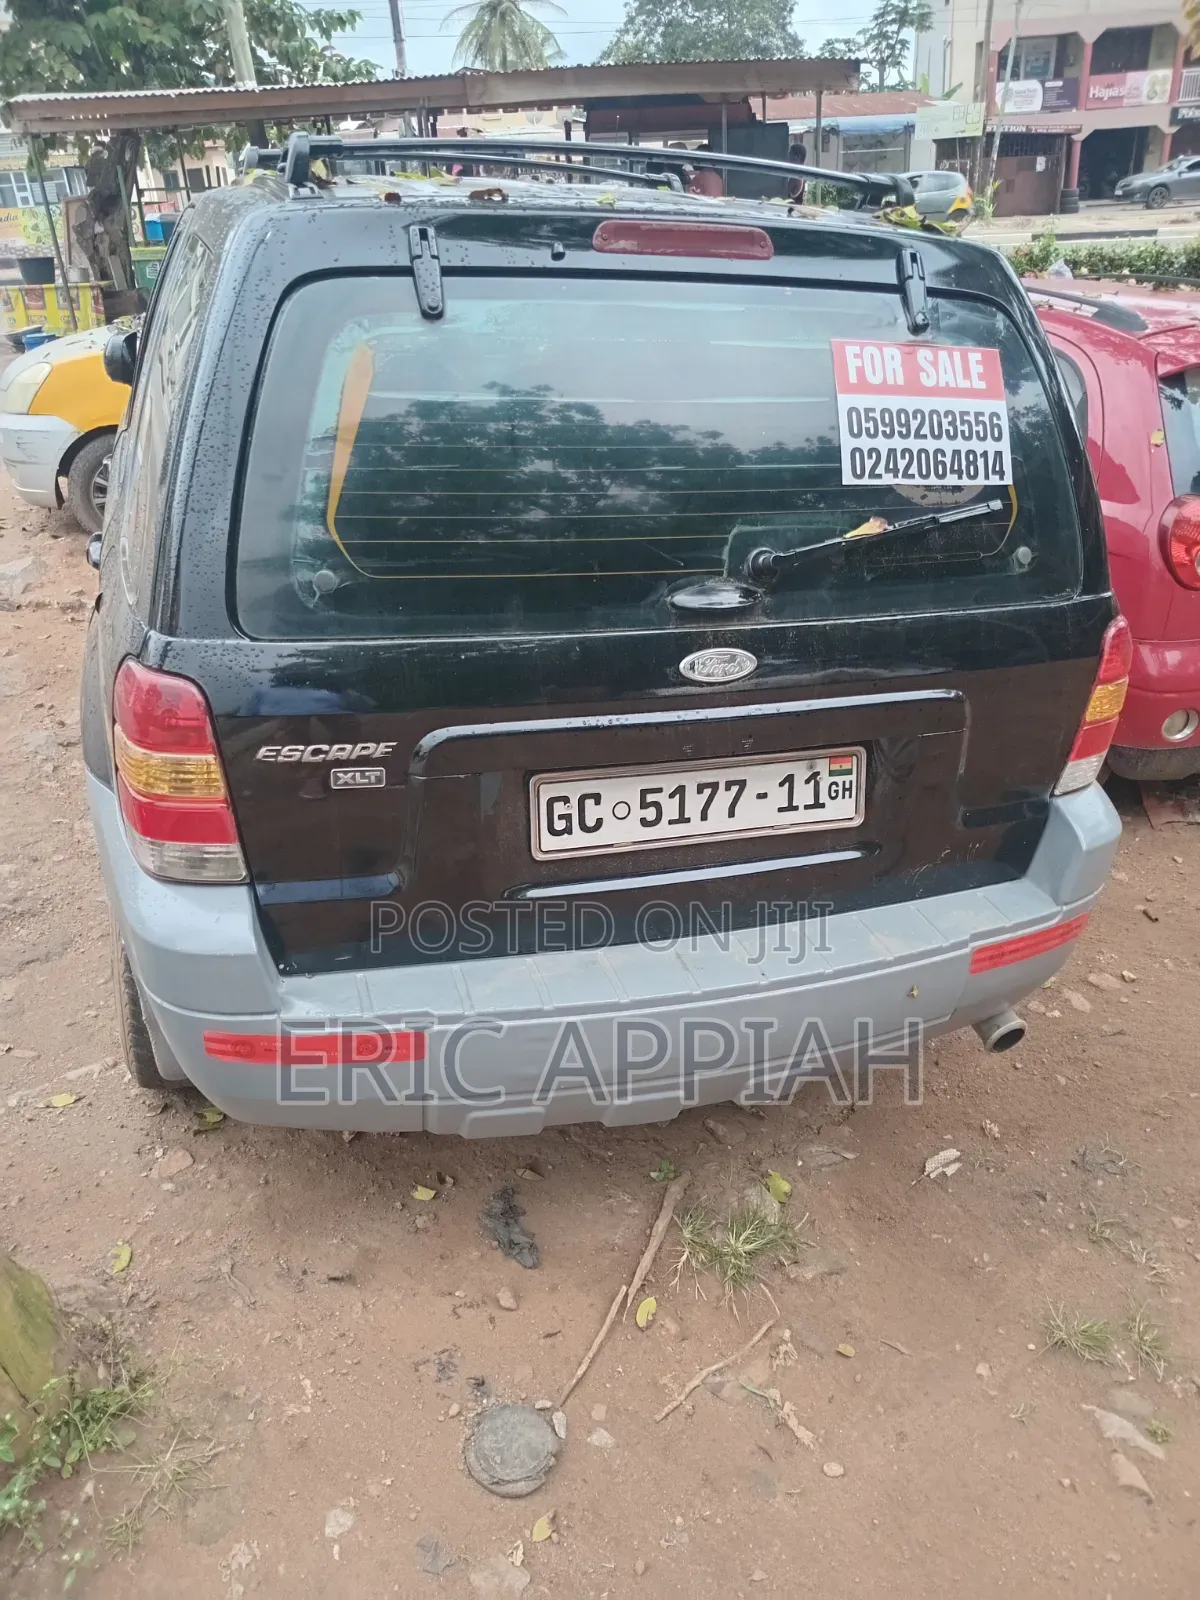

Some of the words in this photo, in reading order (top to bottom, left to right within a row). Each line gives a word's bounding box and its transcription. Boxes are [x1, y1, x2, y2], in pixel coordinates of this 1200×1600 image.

[845, 345, 904, 386] FOR
[917, 350, 987, 389] SALE
[847, 406, 1003, 443] 0599203556
[850, 447, 1005, 481] 0242064814
[254, 741, 399, 763] ESCAPE
[336, 771, 381, 785] XLT
[828, 780, 853, 801] GH
[546, 793, 603, 837] GC
[639, 770, 826, 828] 5177-11
